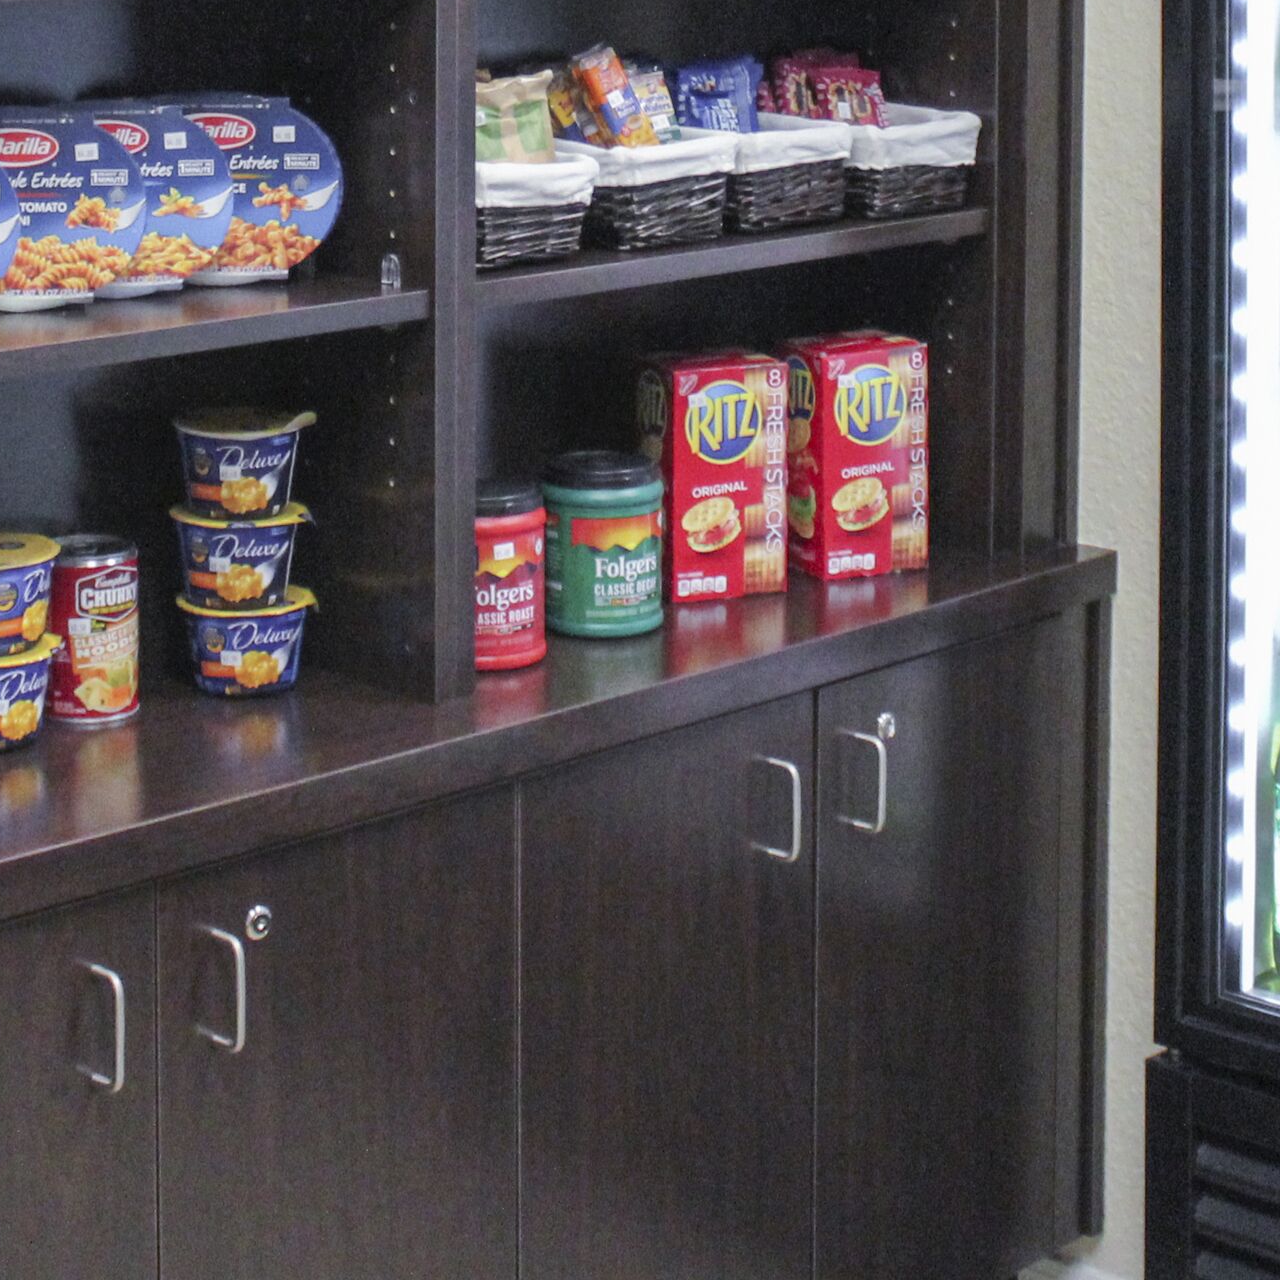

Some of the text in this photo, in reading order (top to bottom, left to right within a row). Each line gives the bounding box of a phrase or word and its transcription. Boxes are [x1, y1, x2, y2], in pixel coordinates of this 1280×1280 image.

[835, 372, 902, 438] RITZ
[686, 388, 758, 456] RITZ
[217, 446, 289, 471] Deluxe
[841, 461, 895, 479] ORIGINAL
[692, 481, 748, 499] ORIGINAL
[214, 534, 287, 561] Deluxe
[595, 555, 657, 581] Folgers
[595, 582, 635, 597] CLASSIC
[228, 621, 300, 650] Deluxe
